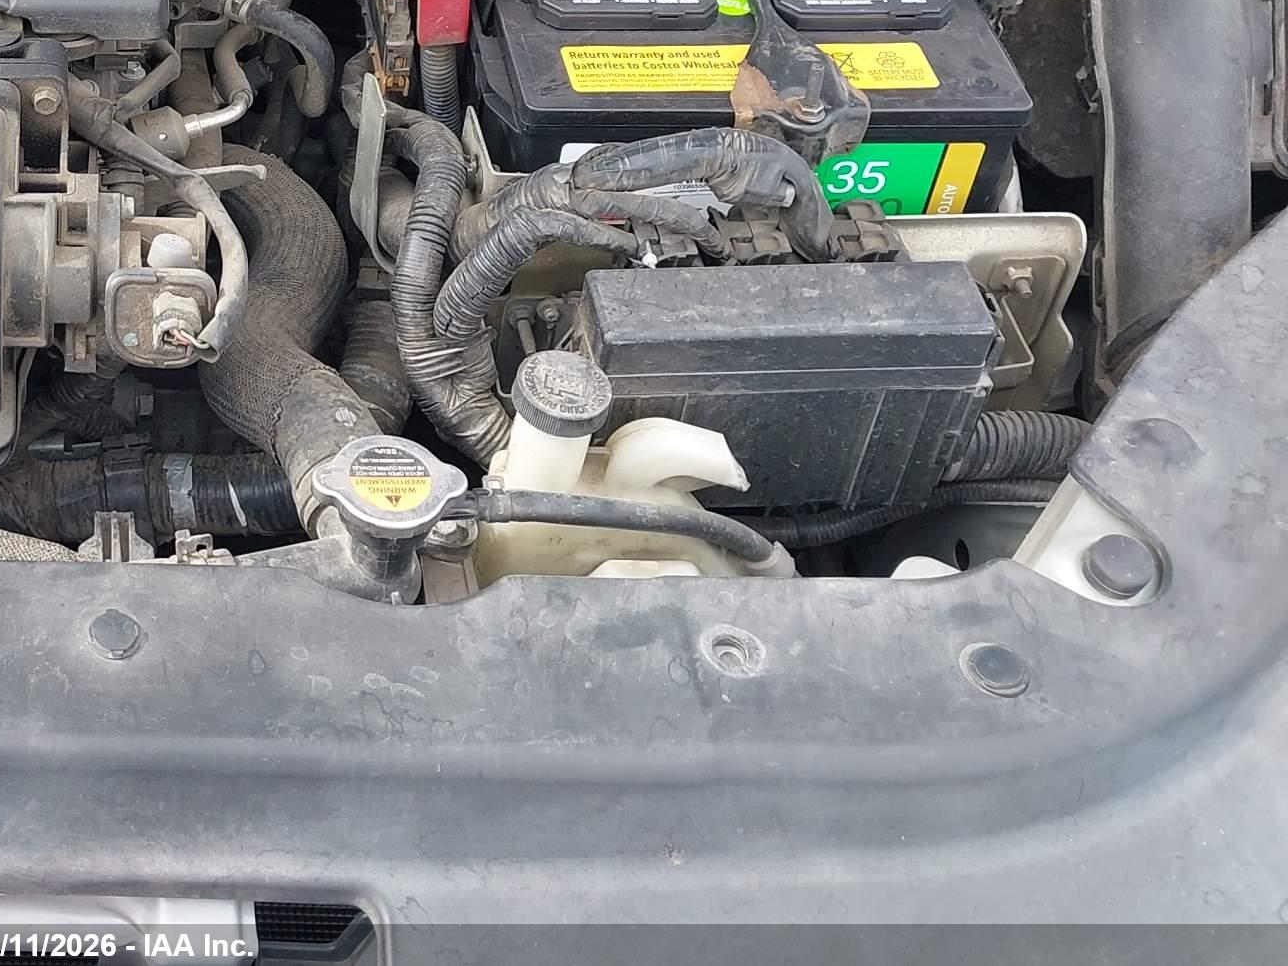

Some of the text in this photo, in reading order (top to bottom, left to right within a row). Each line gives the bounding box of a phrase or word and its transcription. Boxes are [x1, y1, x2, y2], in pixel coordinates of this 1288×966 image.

[569, 50, 721, 61] Return warranty and used
[573, 61, 625, 70] batteries
[627, 62, 640, 70] to
[642, 61, 680, 70] Costco
[826, 160, 890, 195] 35
